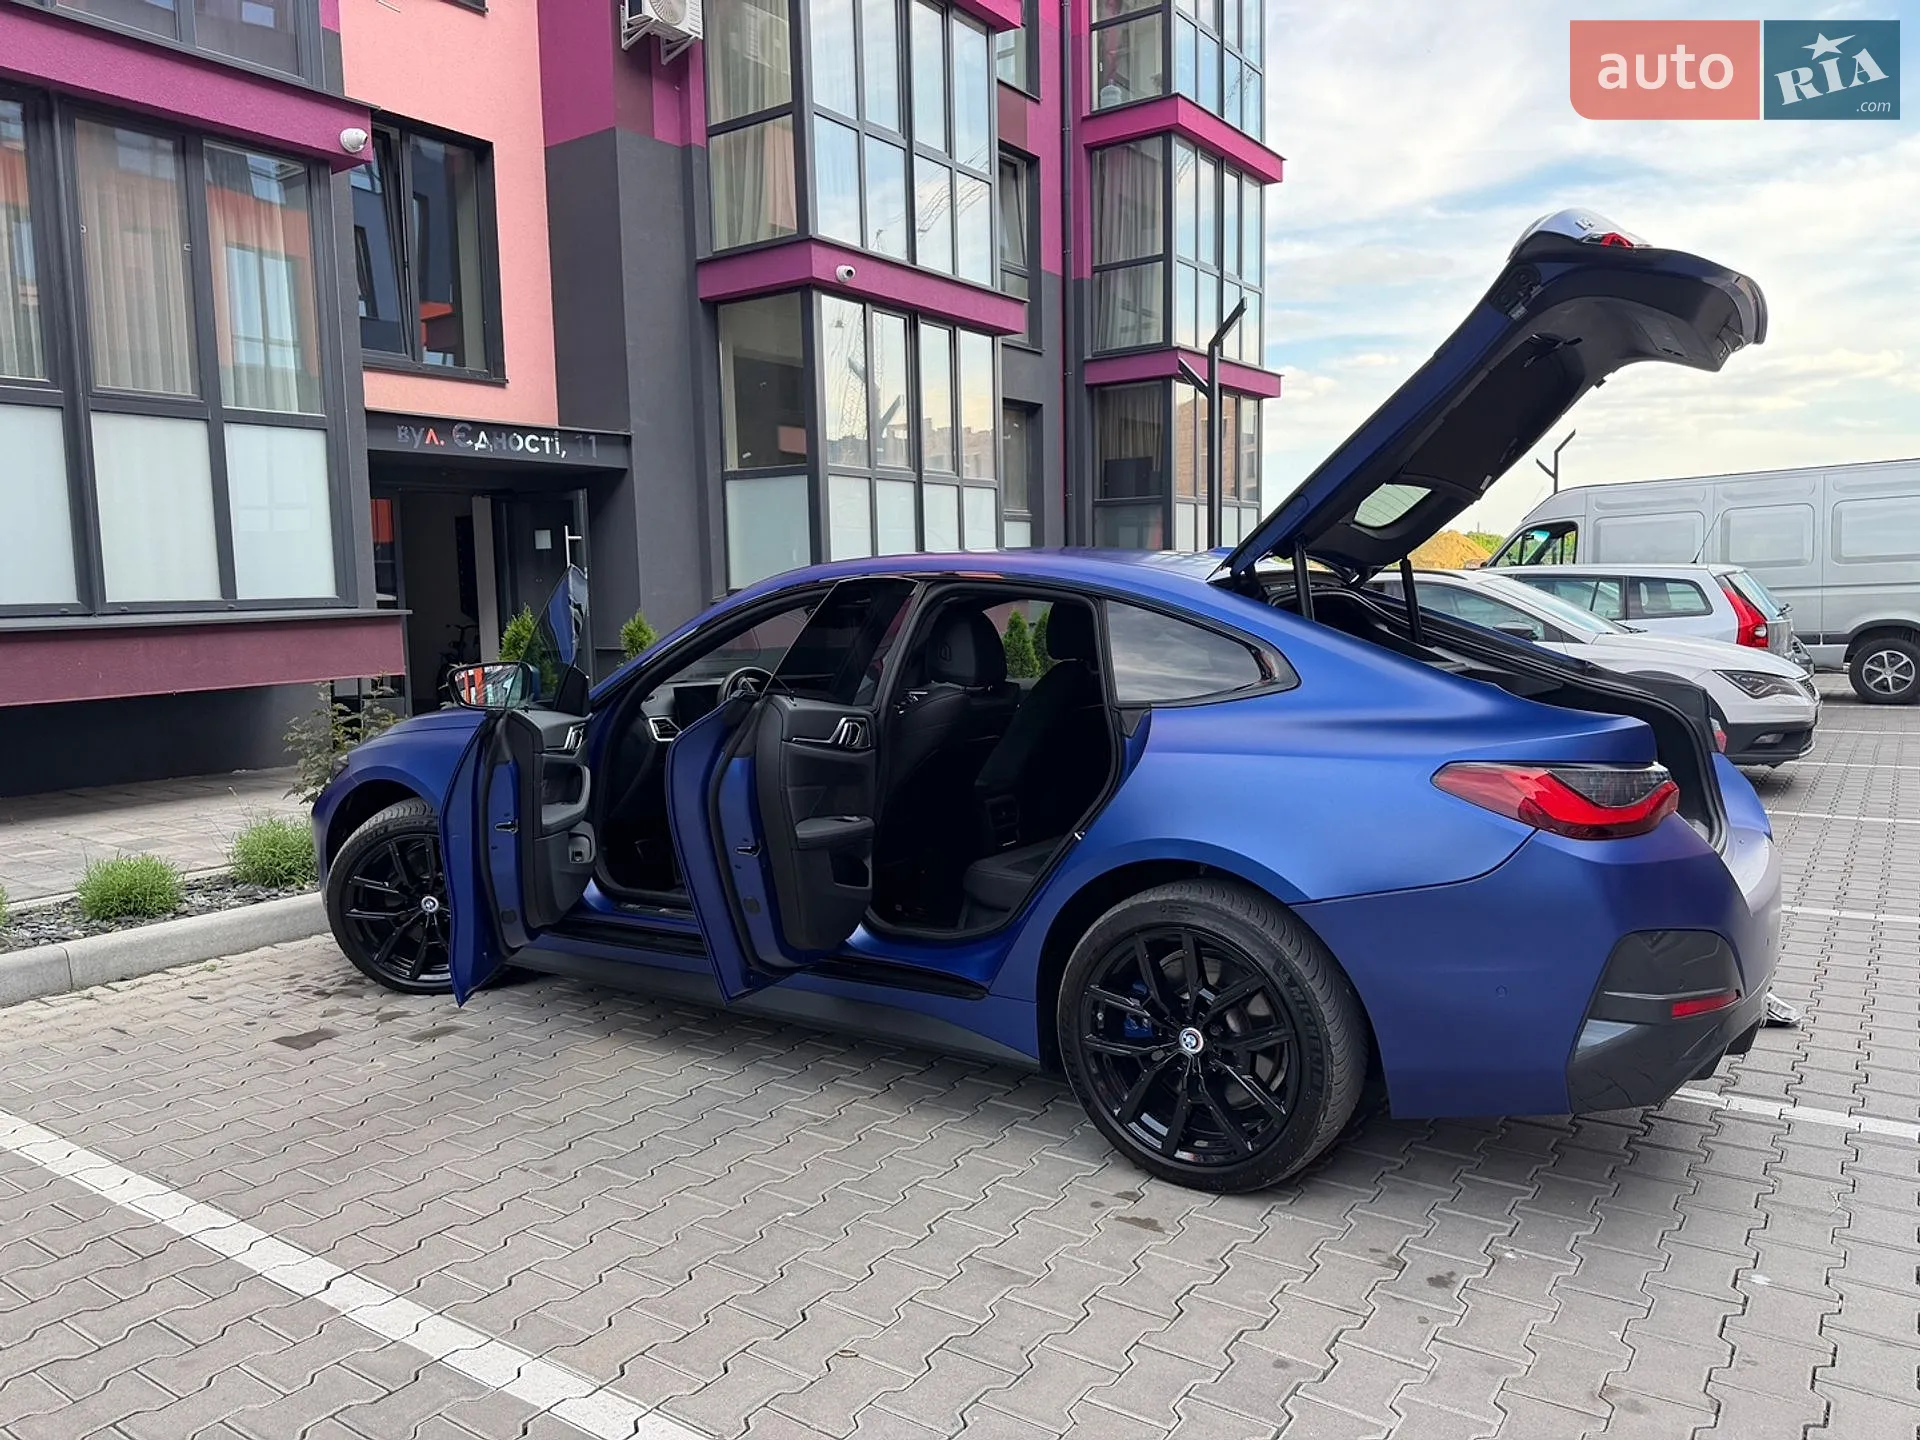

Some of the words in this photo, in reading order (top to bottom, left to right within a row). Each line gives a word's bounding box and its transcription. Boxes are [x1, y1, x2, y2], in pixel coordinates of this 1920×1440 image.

[396, 424, 445, 449] вул.
[451, 422, 567, 459] Єдності,
[575, 434, 598, 459] 11
